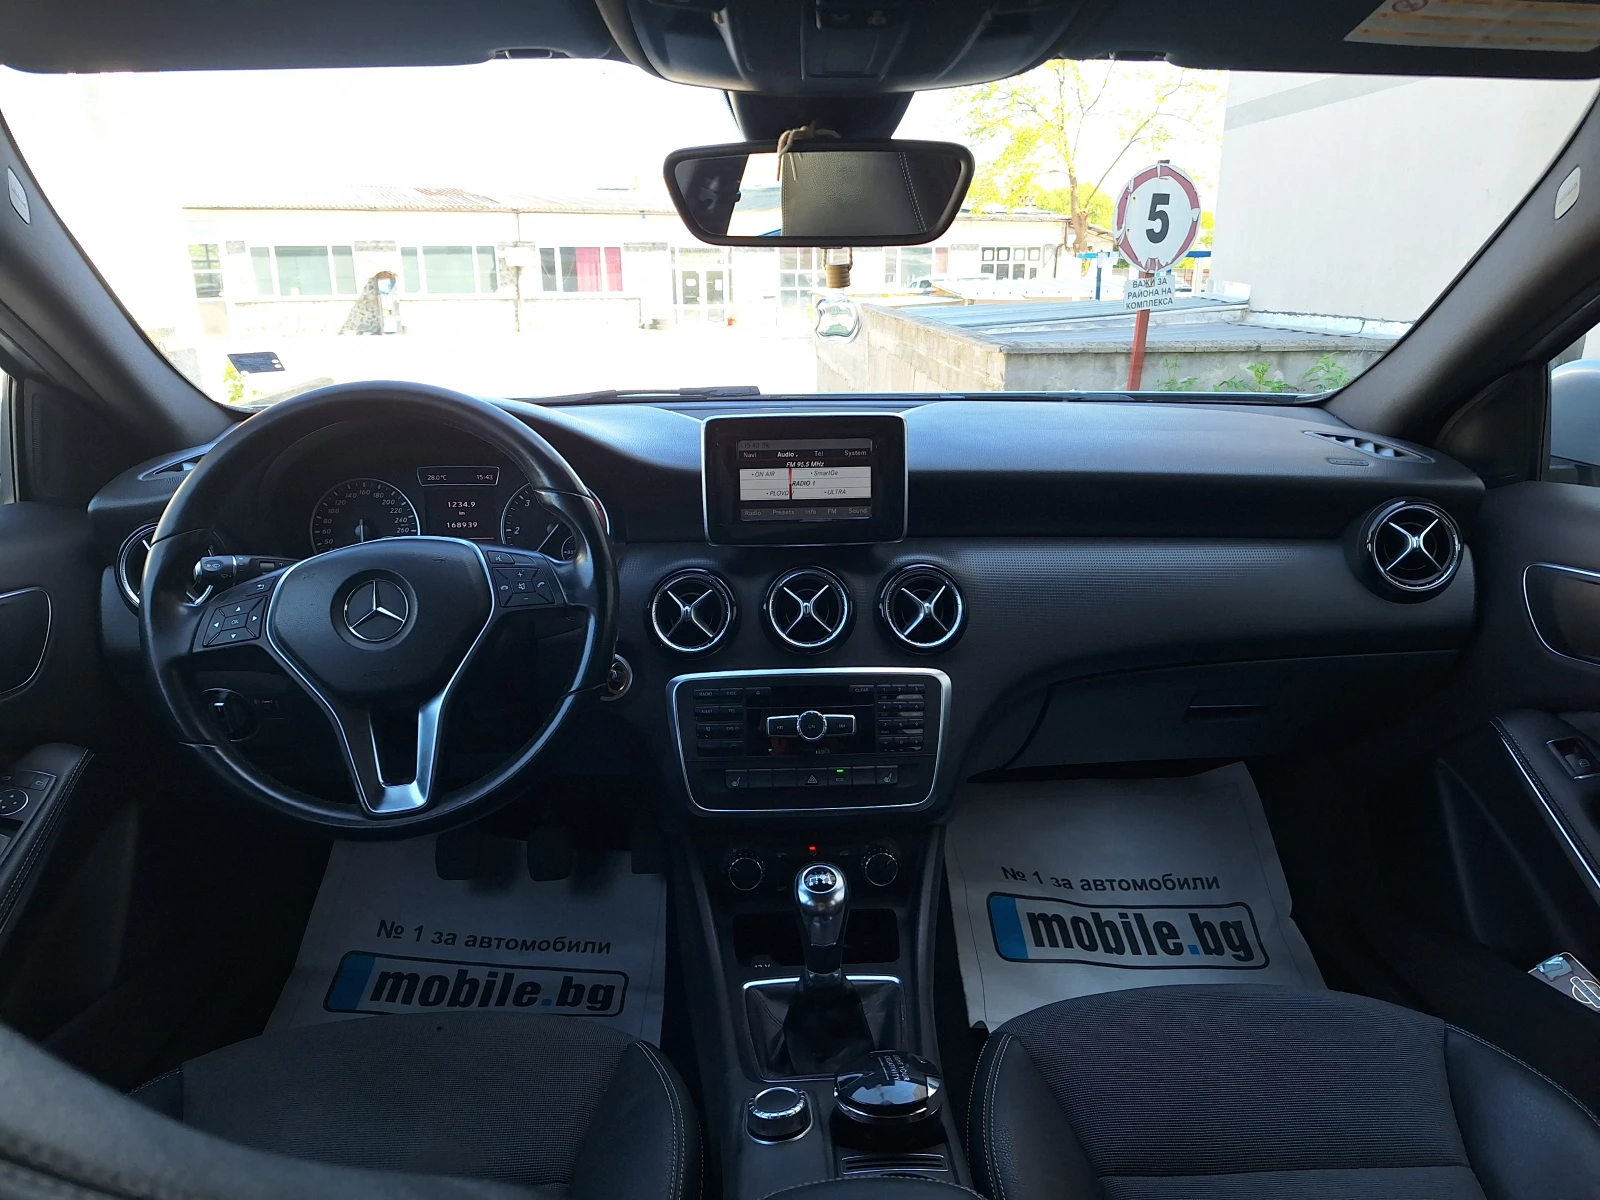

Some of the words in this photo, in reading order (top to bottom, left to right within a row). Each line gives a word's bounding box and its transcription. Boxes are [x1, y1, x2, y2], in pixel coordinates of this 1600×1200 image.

[1145, 193, 1170, 244] 5
[1132, 278, 1155, 288] ВАЖИ
[1157, 277, 1167, 286] ЗА
[1127, 288, 1160, 299] РАЙОНА
[1161, 287, 1172, 295] НА
[1126, 297, 1173, 310] КОМПЛЕКСА
[844, 450, 867, 458] System
[524, 499, 531, 507] 3
[513, 526, 520, 535] 2
[1032, 870, 1044, 885] 1
[1050, 876, 1075, 891] за
[1080, 872, 1220, 892] автомобили
[413, 924, 424, 943] 1
[431, 930, 457, 946] за
[464, 934, 612, 955] автомобили
[1025, 911, 1255, 962] mobile.bg
[369, 968, 616, 1012] mobile.bg
